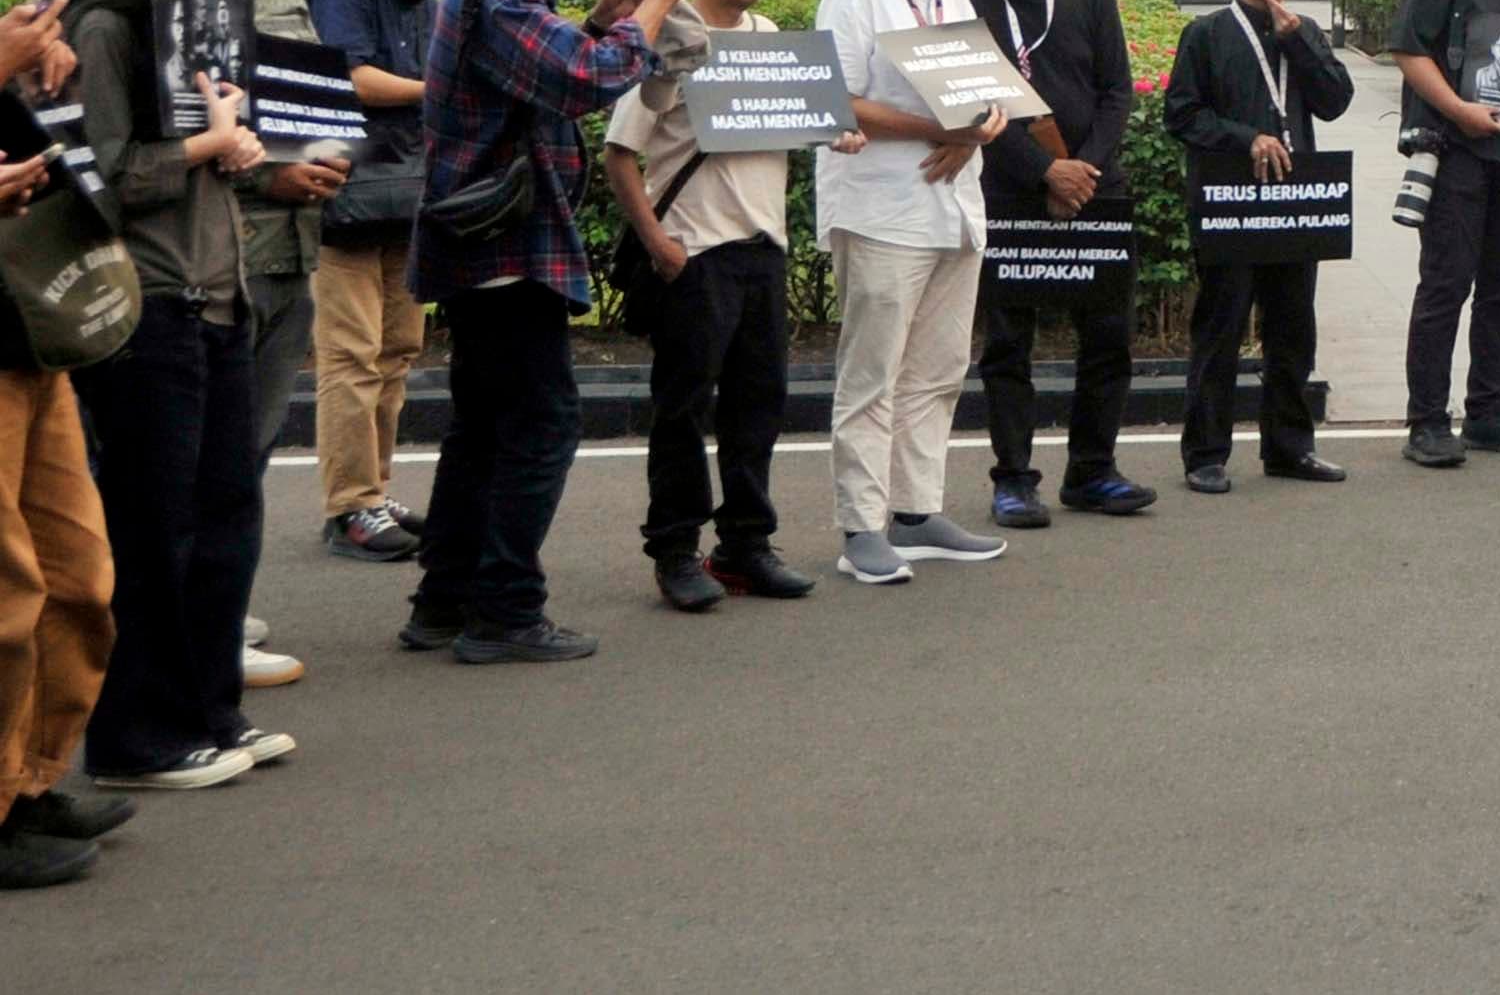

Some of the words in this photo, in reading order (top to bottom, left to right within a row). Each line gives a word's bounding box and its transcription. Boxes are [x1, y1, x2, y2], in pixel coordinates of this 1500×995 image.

[730, 50, 798, 63] KELUARGA
[692, 66, 742, 82] MASIH
[744, 65, 832, 81] MENUNGGU
[742, 98, 807, 110] HARAPAN
[711, 114, 762, 129] MASIH
[764, 112, 836, 129] MENYALA
[1203, 184, 1257, 202] TERUS
[1260, 182, 1349, 201] BERHARAP
[987, 220, 1012, 230] GAN
[1014, 220, 1068, 231] HENTIKAN
[1070, 220, 1133, 232] PENCARIAN
[1201, 217, 1241, 230] BAWA
[1242, 216, 1296, 229] MEREKA
[1298, 214, 1350, 228] PULANG
[1020, 247, 1076, 260] BIARKAN
[1078, 249, 1129, 260] MEREKA
[998, 264, 1095, 280] DILUPAKAN
